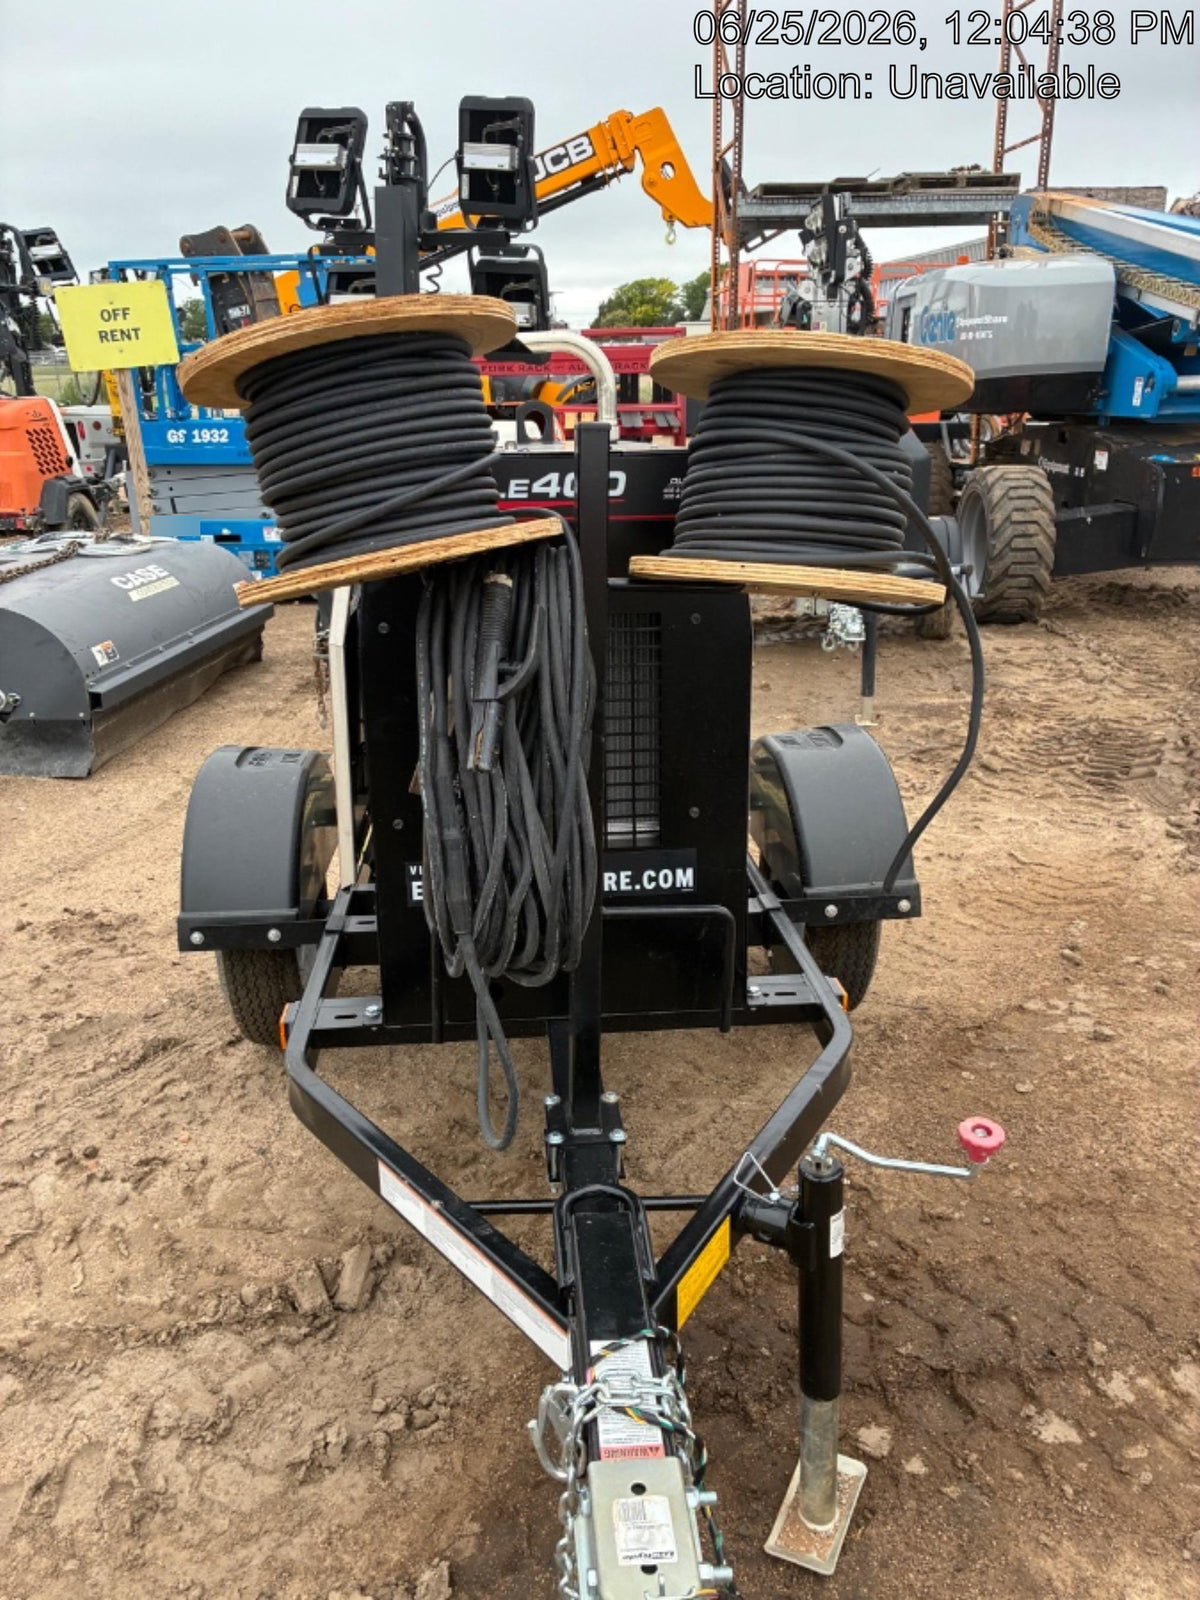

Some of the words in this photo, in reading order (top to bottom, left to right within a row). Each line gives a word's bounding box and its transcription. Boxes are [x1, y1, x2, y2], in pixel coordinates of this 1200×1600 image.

[534, 135, 594, 180] JCB
[100, 307, 131, 322] OFF
[98, 327, 141, 343] RENT
[191, 428, 229, 443] 1932
[110, 564, 171, 590] CASE
[603, 867, 695, 892] RE.COM
